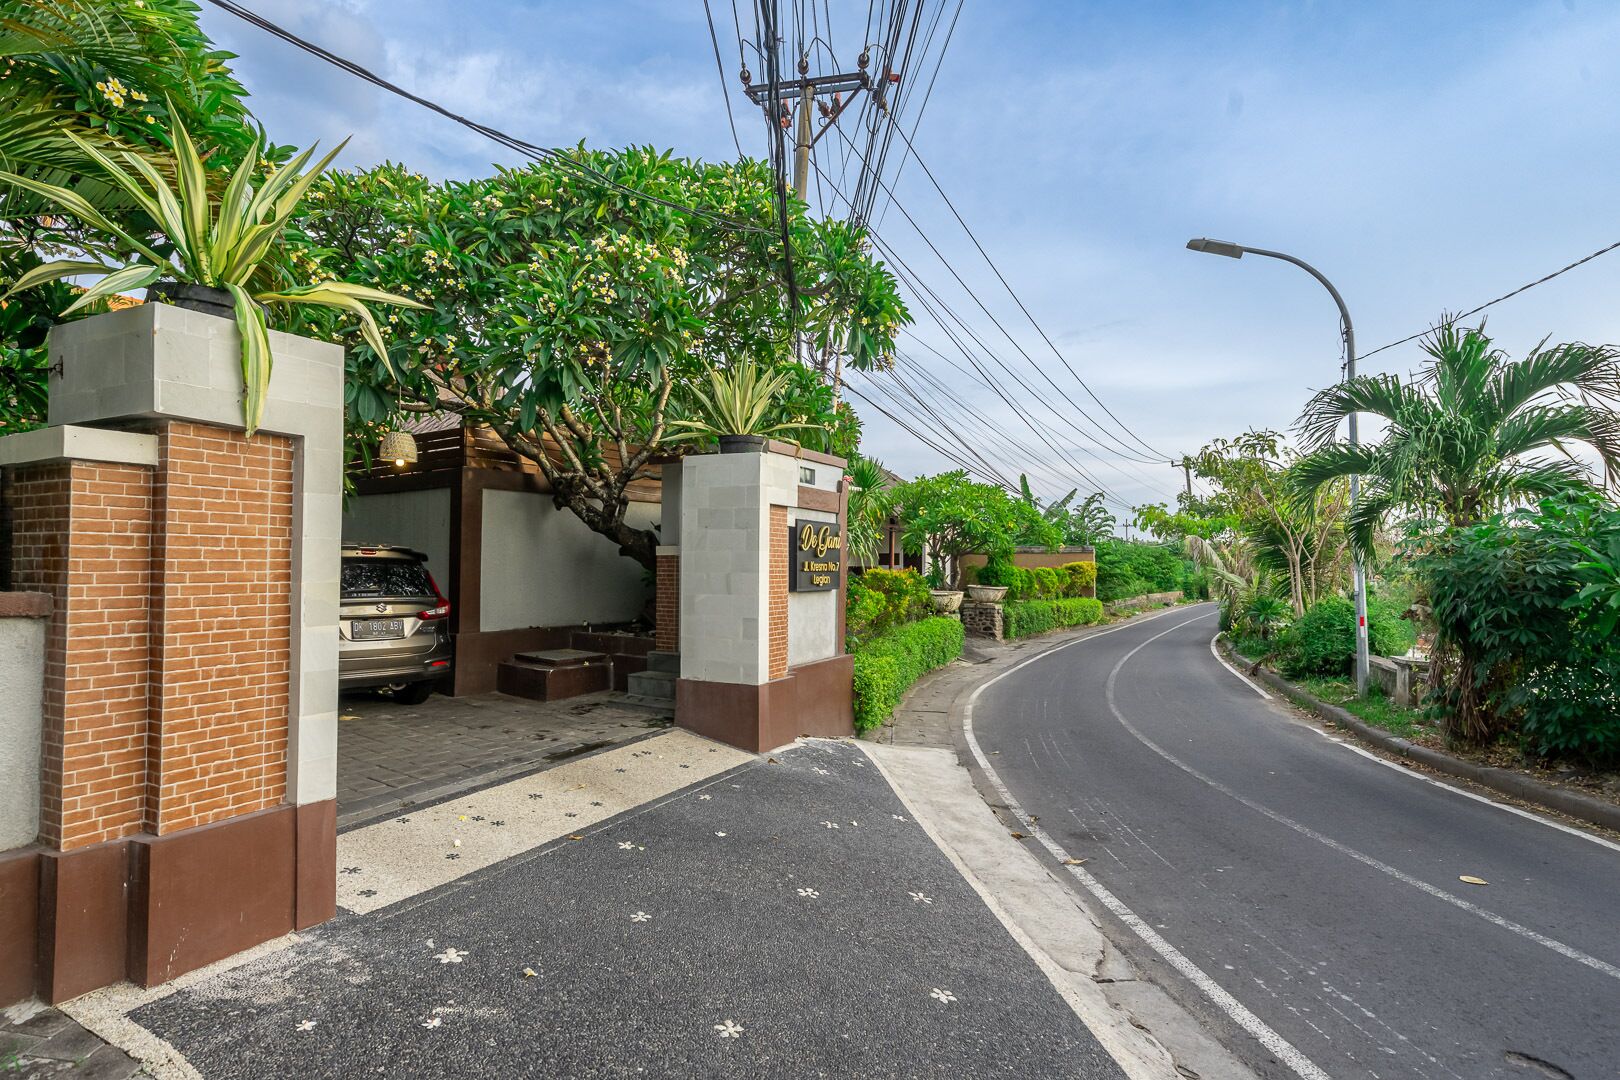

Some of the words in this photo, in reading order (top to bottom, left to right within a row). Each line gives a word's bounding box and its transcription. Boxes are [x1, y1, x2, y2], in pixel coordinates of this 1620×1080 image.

[810, 561, 828, 572] Kresna
[814, 574, 830, 586] Legian
[354, 622, 363, 632] DK
[369, 622, 386, 630] 1802
